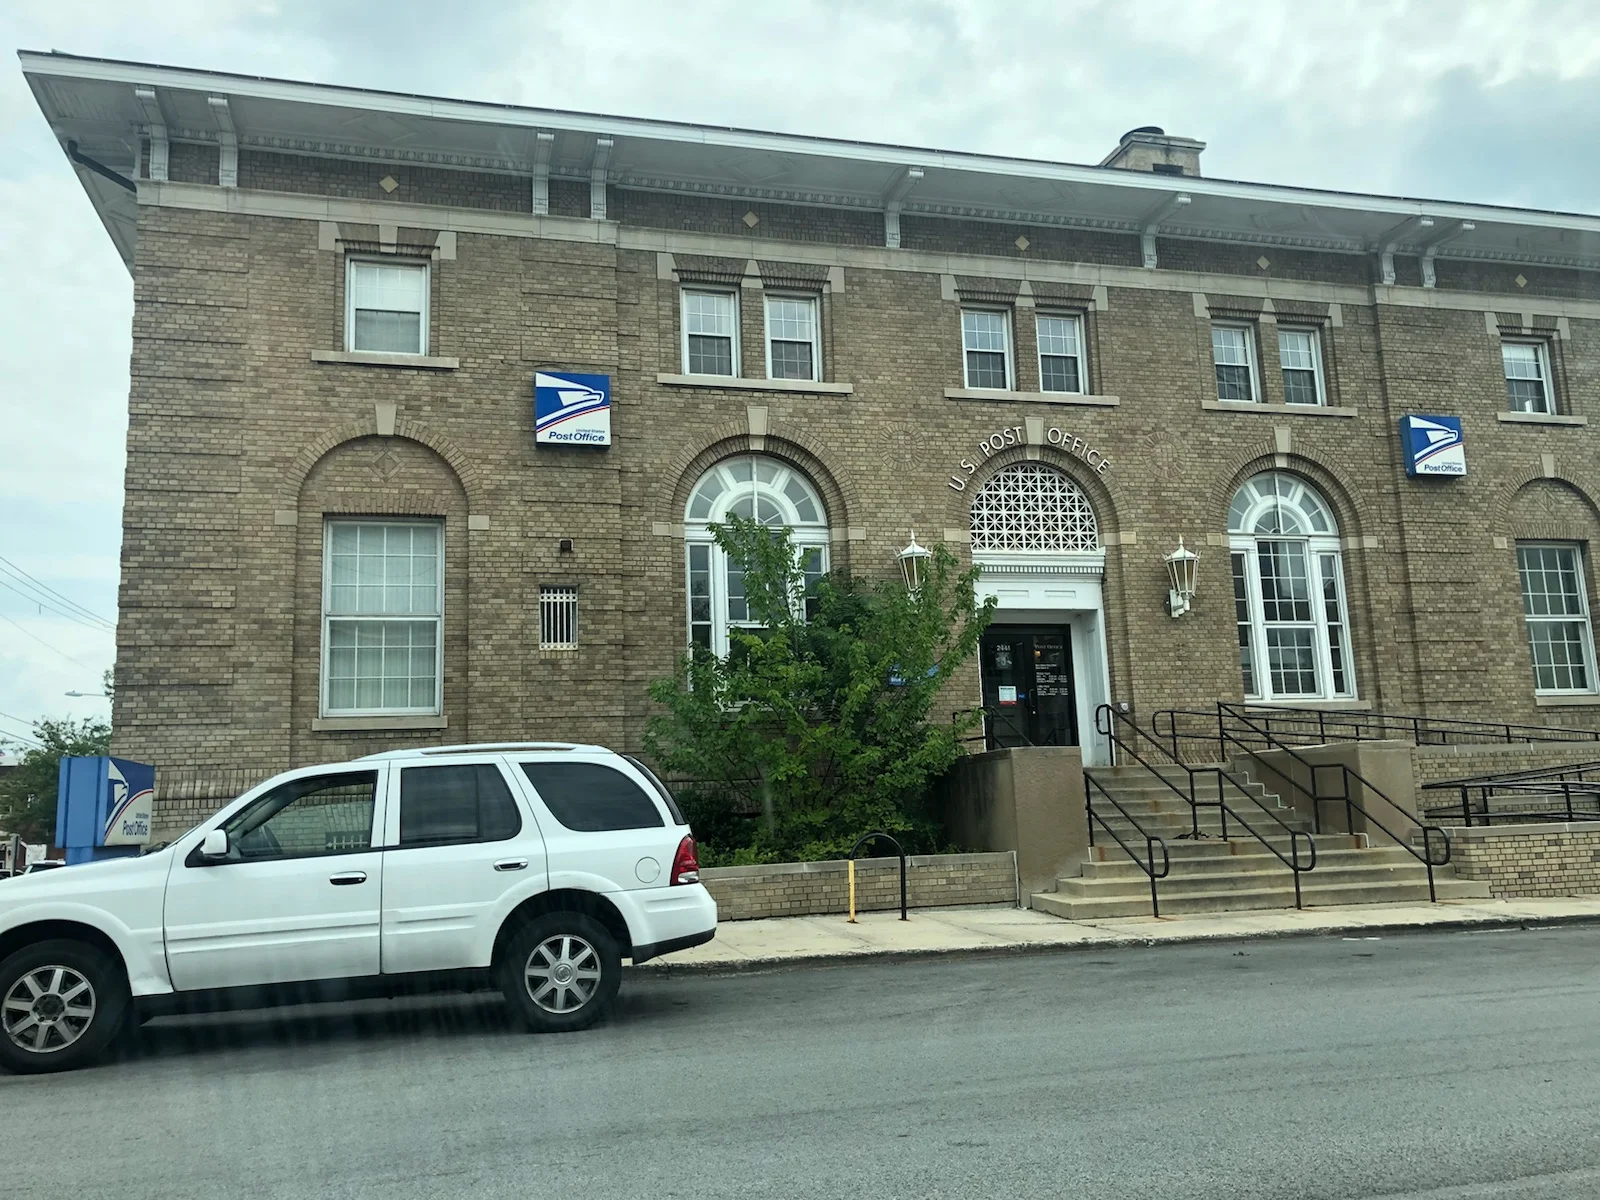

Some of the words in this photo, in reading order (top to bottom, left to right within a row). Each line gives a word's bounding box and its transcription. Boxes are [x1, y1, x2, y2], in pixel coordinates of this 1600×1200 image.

[548, 431, 573, 440] Post
[573, 432, 605, 442] Office
[948, 458, 979, 492] U.S.
[979, 426, 1023, 457] POST
[1047, 427, 1111, 475] OFFICE
